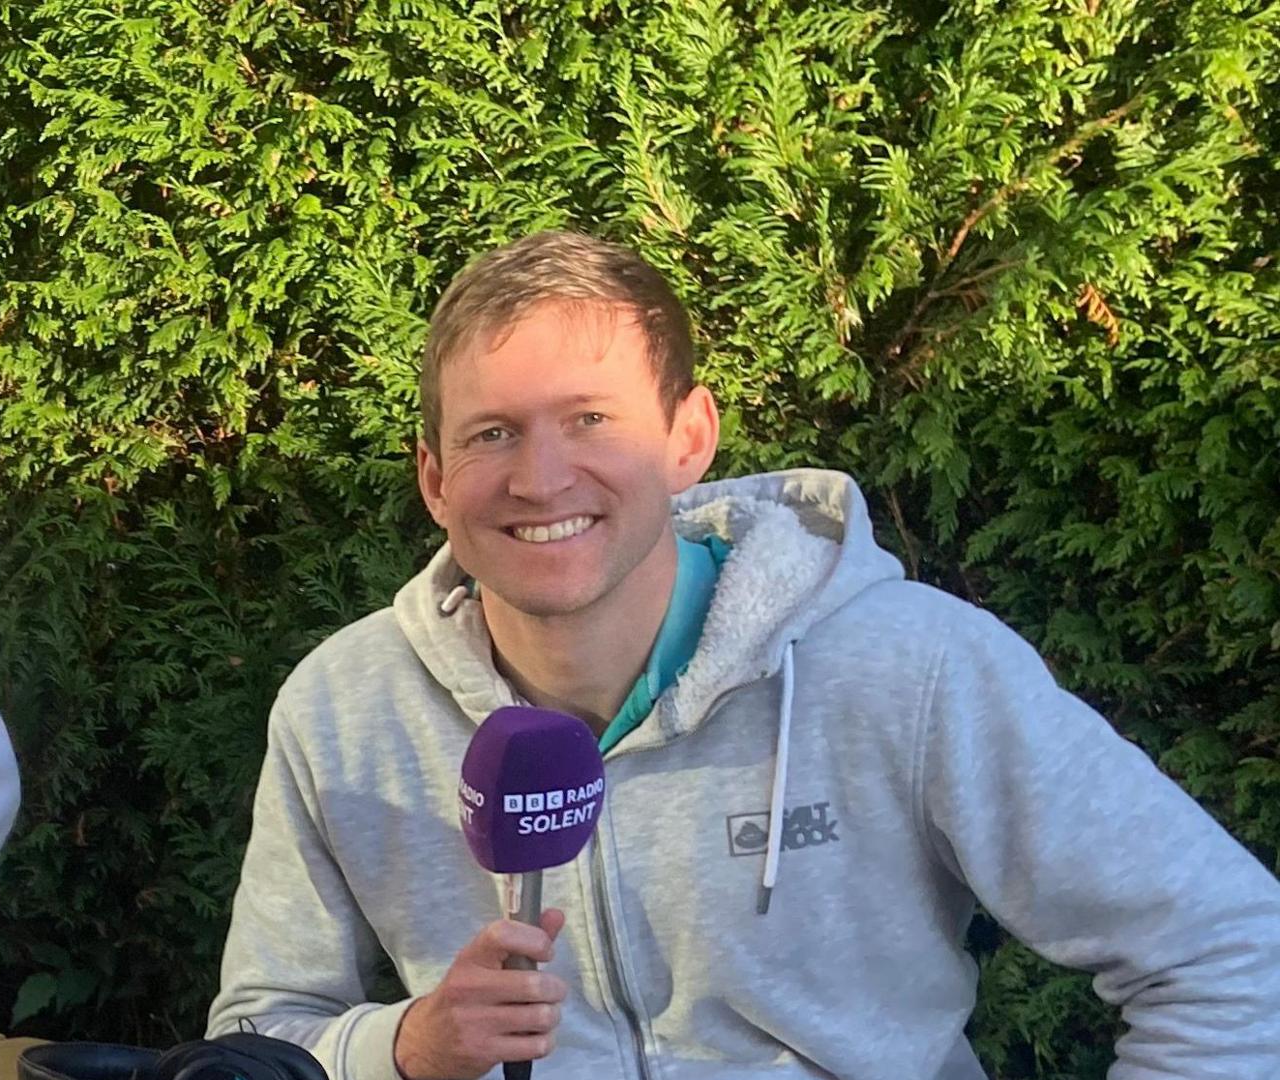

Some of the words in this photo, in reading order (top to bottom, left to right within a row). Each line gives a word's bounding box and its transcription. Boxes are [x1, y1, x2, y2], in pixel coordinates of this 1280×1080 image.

[503, 790, 563, 813] BBC
[566, 778, 604, 804] RADIO
[518, 801, 597, 835] SOLENT
